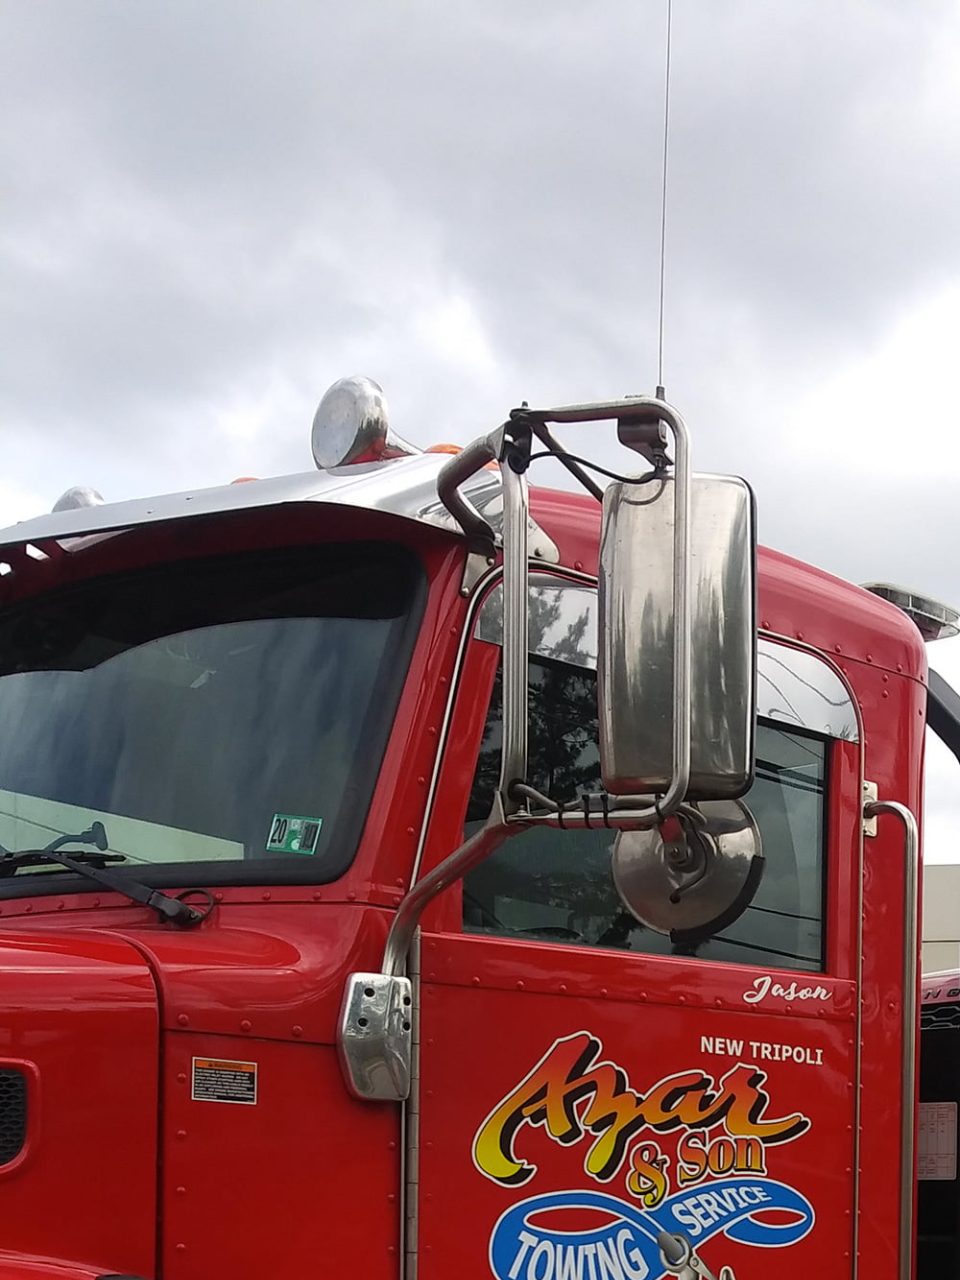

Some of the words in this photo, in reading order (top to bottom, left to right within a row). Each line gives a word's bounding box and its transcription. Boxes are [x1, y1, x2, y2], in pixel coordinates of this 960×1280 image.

[270, 818, 288, 844] 20
[743, 976, 833, 1003] Jason
[701, 1035, 744, 1057] NEW
[749, 1041, 823, 1065] TRIPOLI
[473, 1031, 811, 1188] Azar
[628, 1142, 668, 1209] &
[677, 1130, 766, 1184] Son
[671, 1186, 773, 1237] SERVICE
